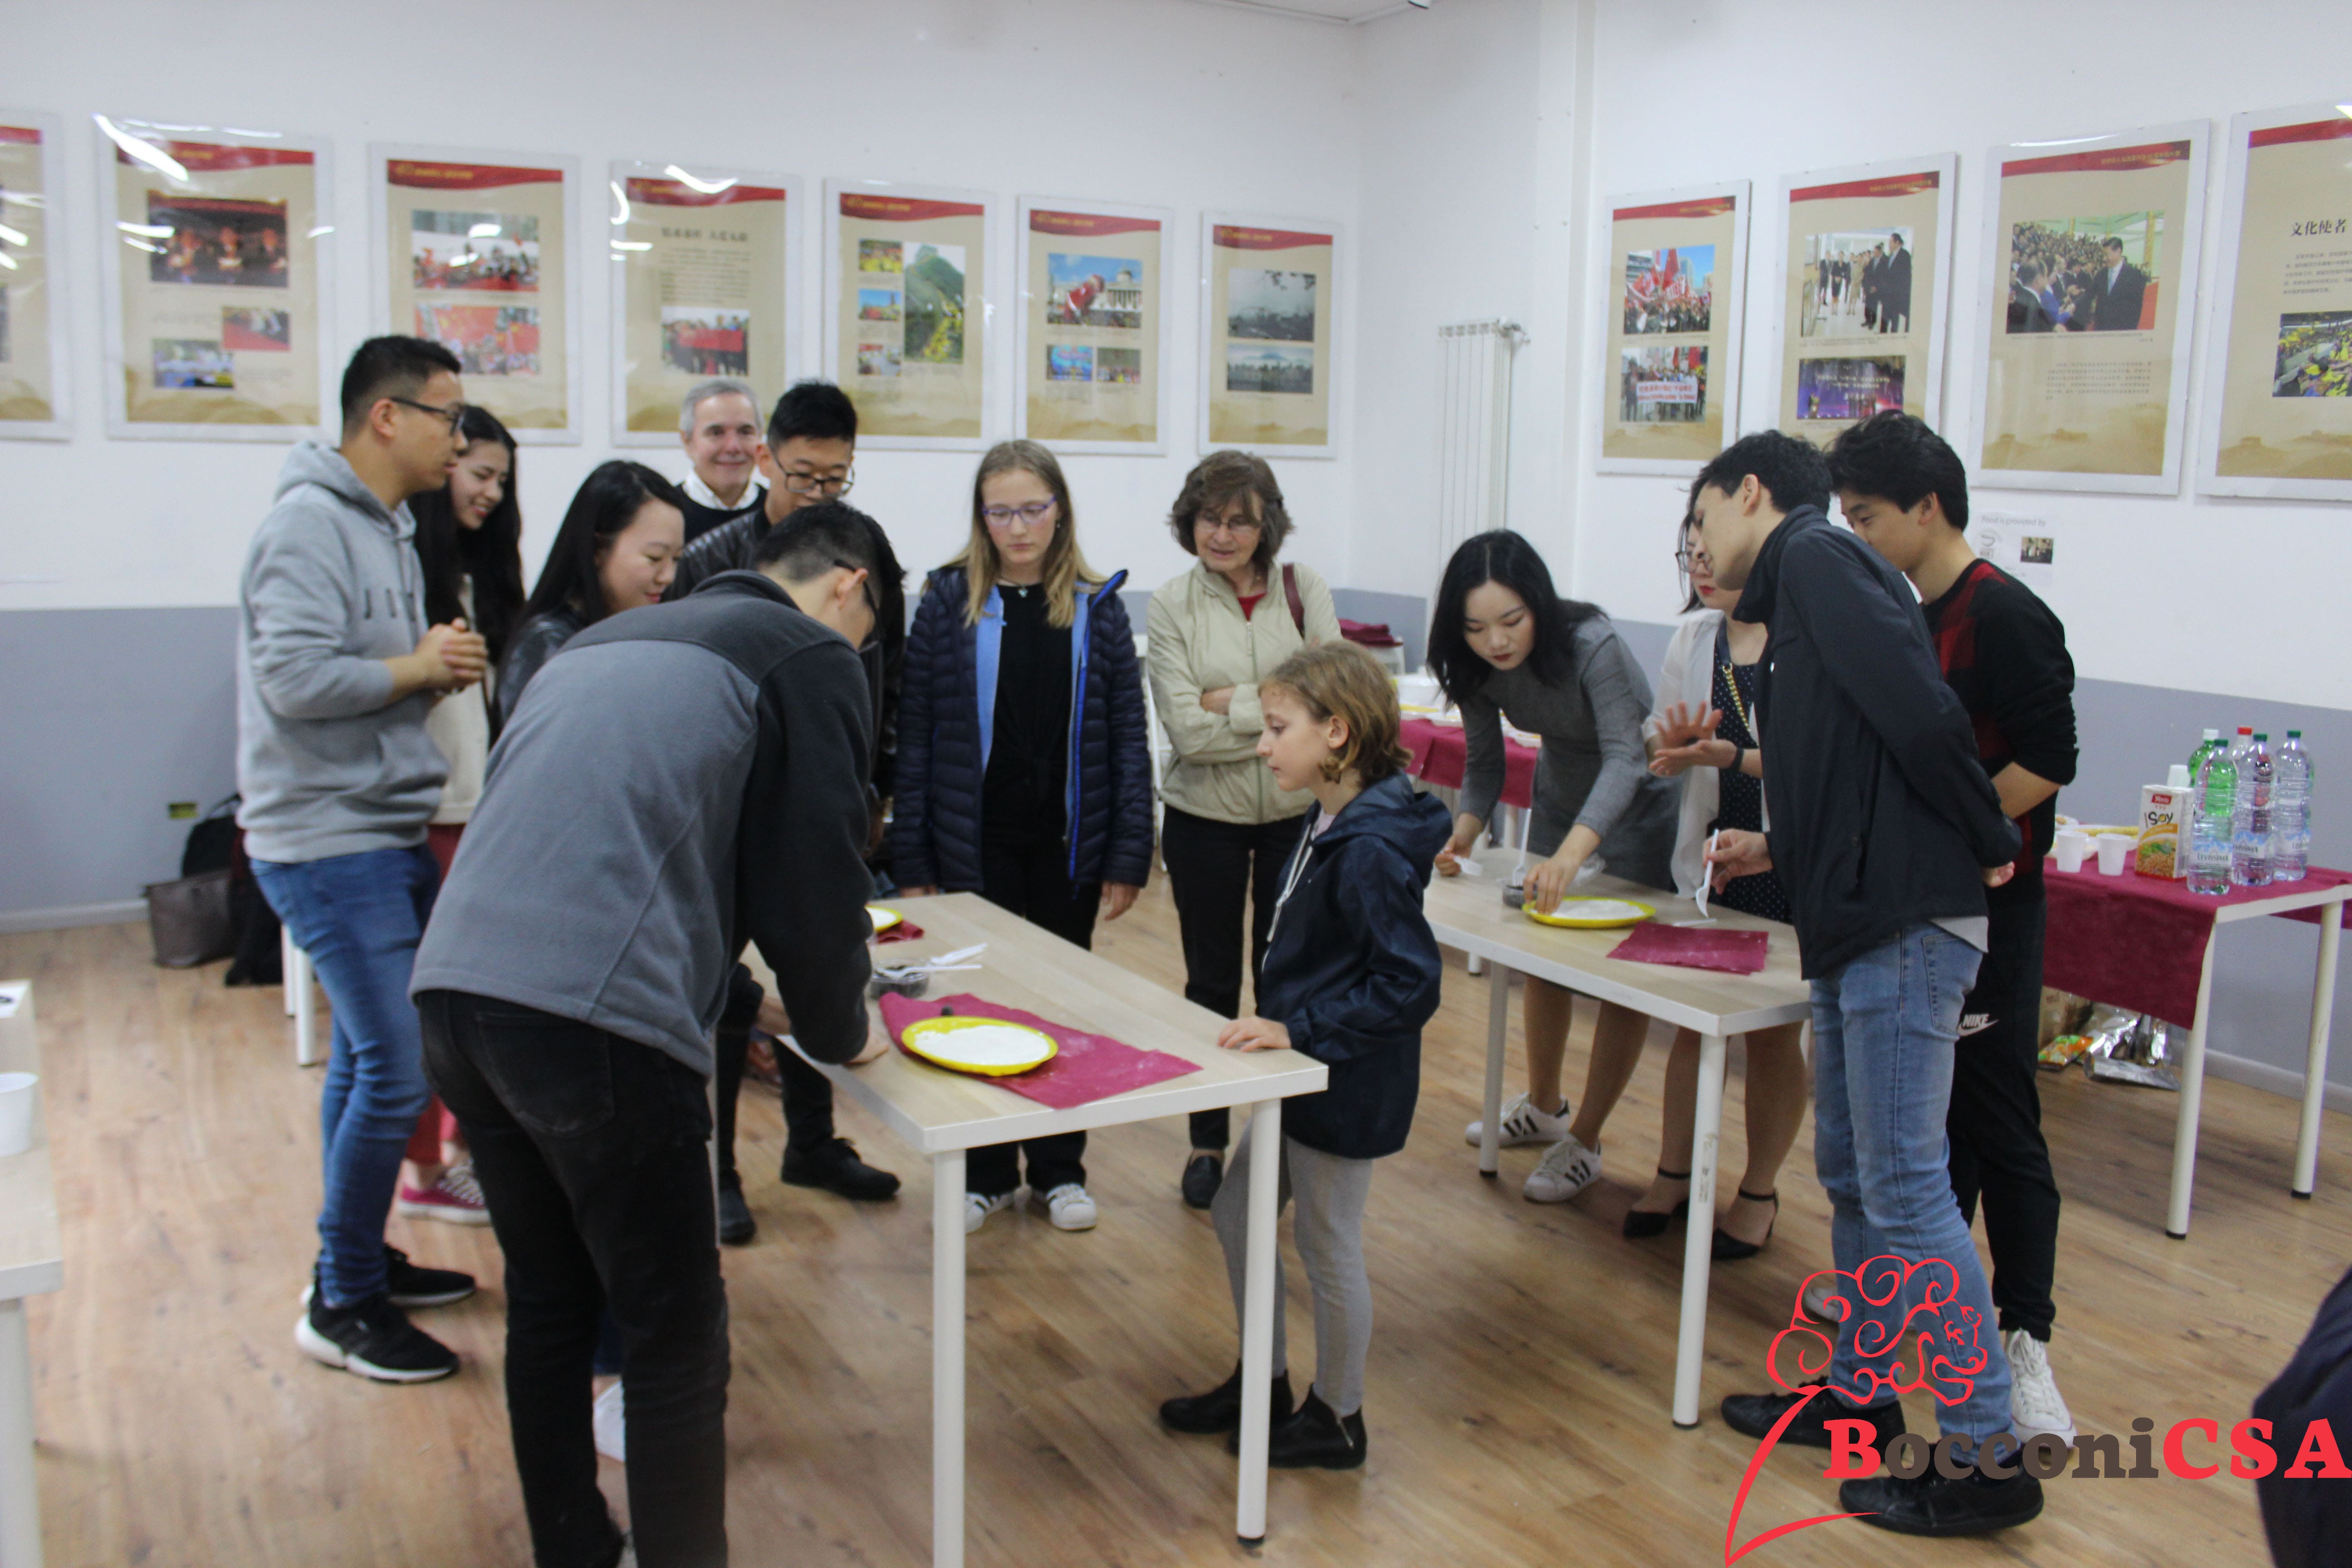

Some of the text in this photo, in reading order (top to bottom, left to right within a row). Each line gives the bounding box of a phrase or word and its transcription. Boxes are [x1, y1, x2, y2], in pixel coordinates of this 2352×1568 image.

[2291, 219, 2347, 236] 文化使者
[1962, 1014, 1989, 1027] NIKE
